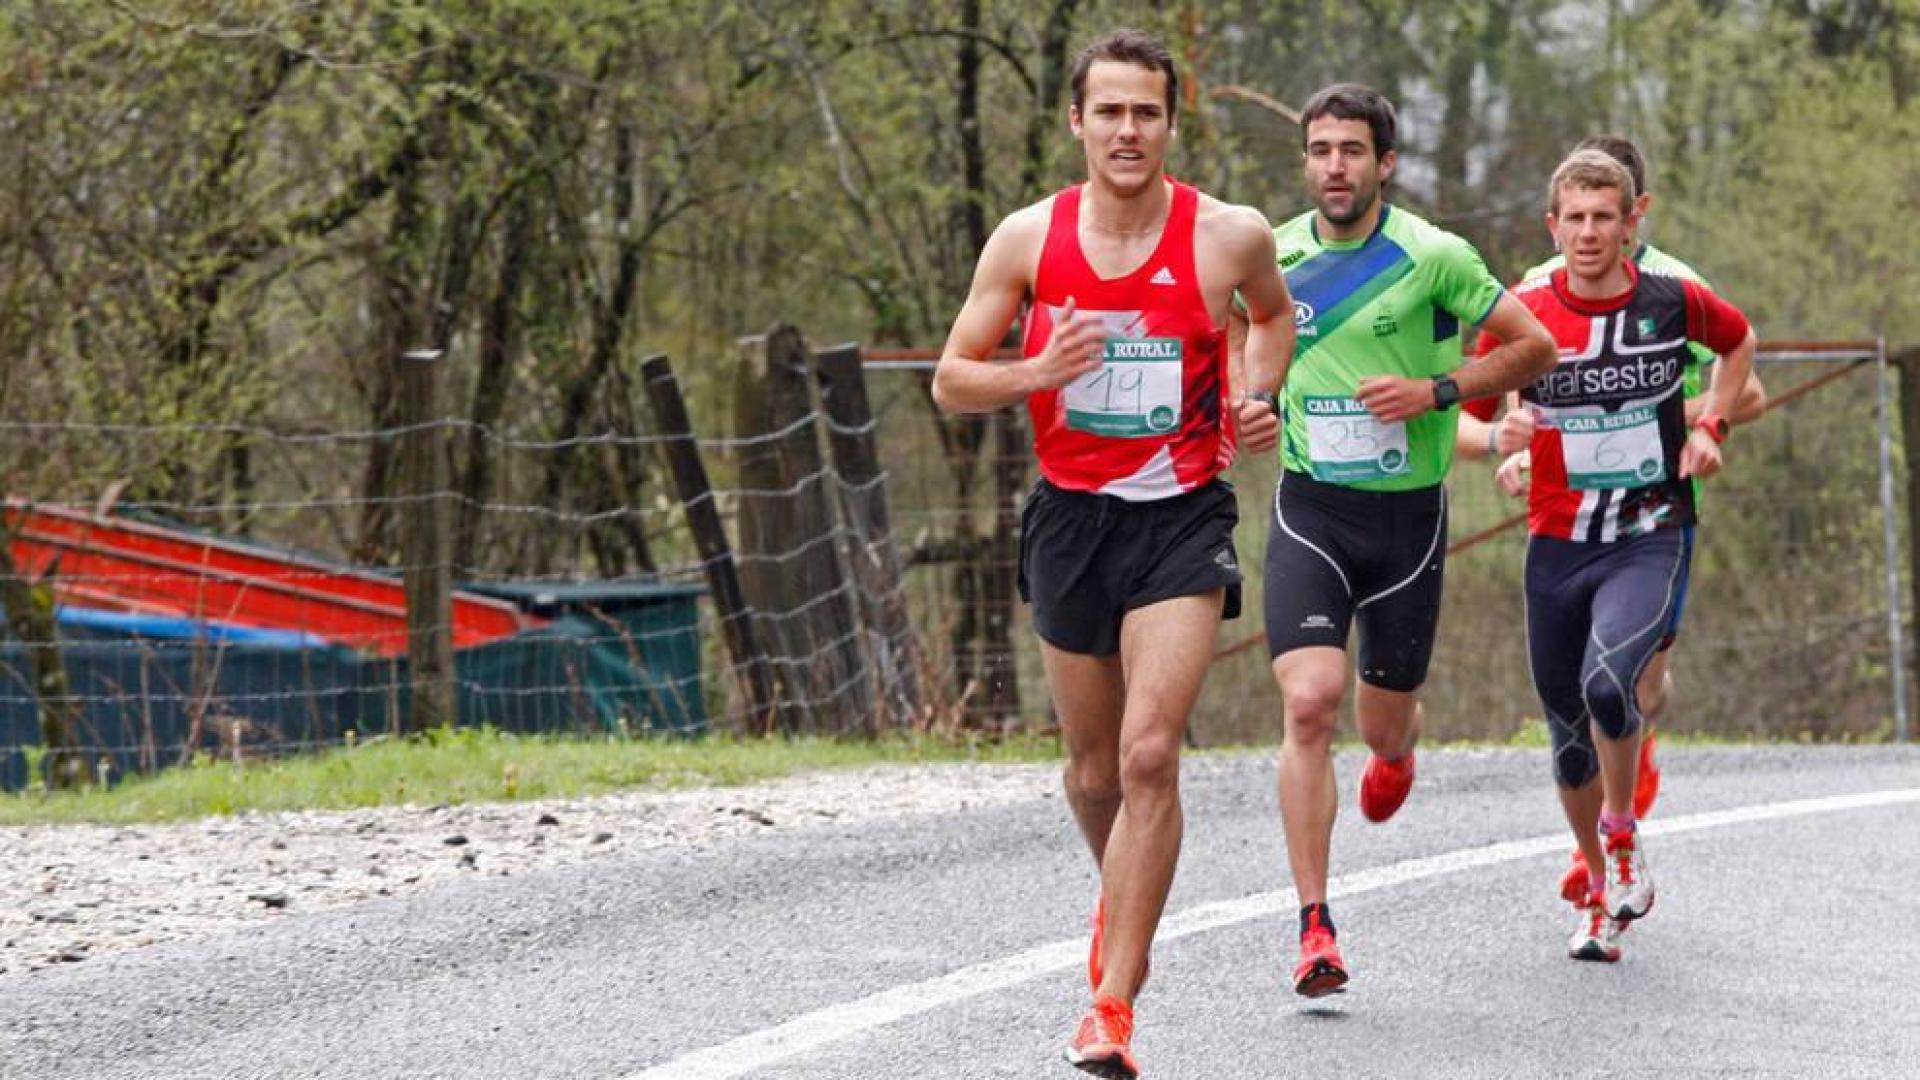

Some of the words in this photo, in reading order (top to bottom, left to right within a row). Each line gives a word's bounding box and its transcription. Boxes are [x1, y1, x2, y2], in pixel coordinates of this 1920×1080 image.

[1113, 342, 1178, 358] RURAL
[1086, 366, 1144, 415] 19
[1603, 408, 1654, 430] RURAL
[1594, 430, 1627, 468] 6
